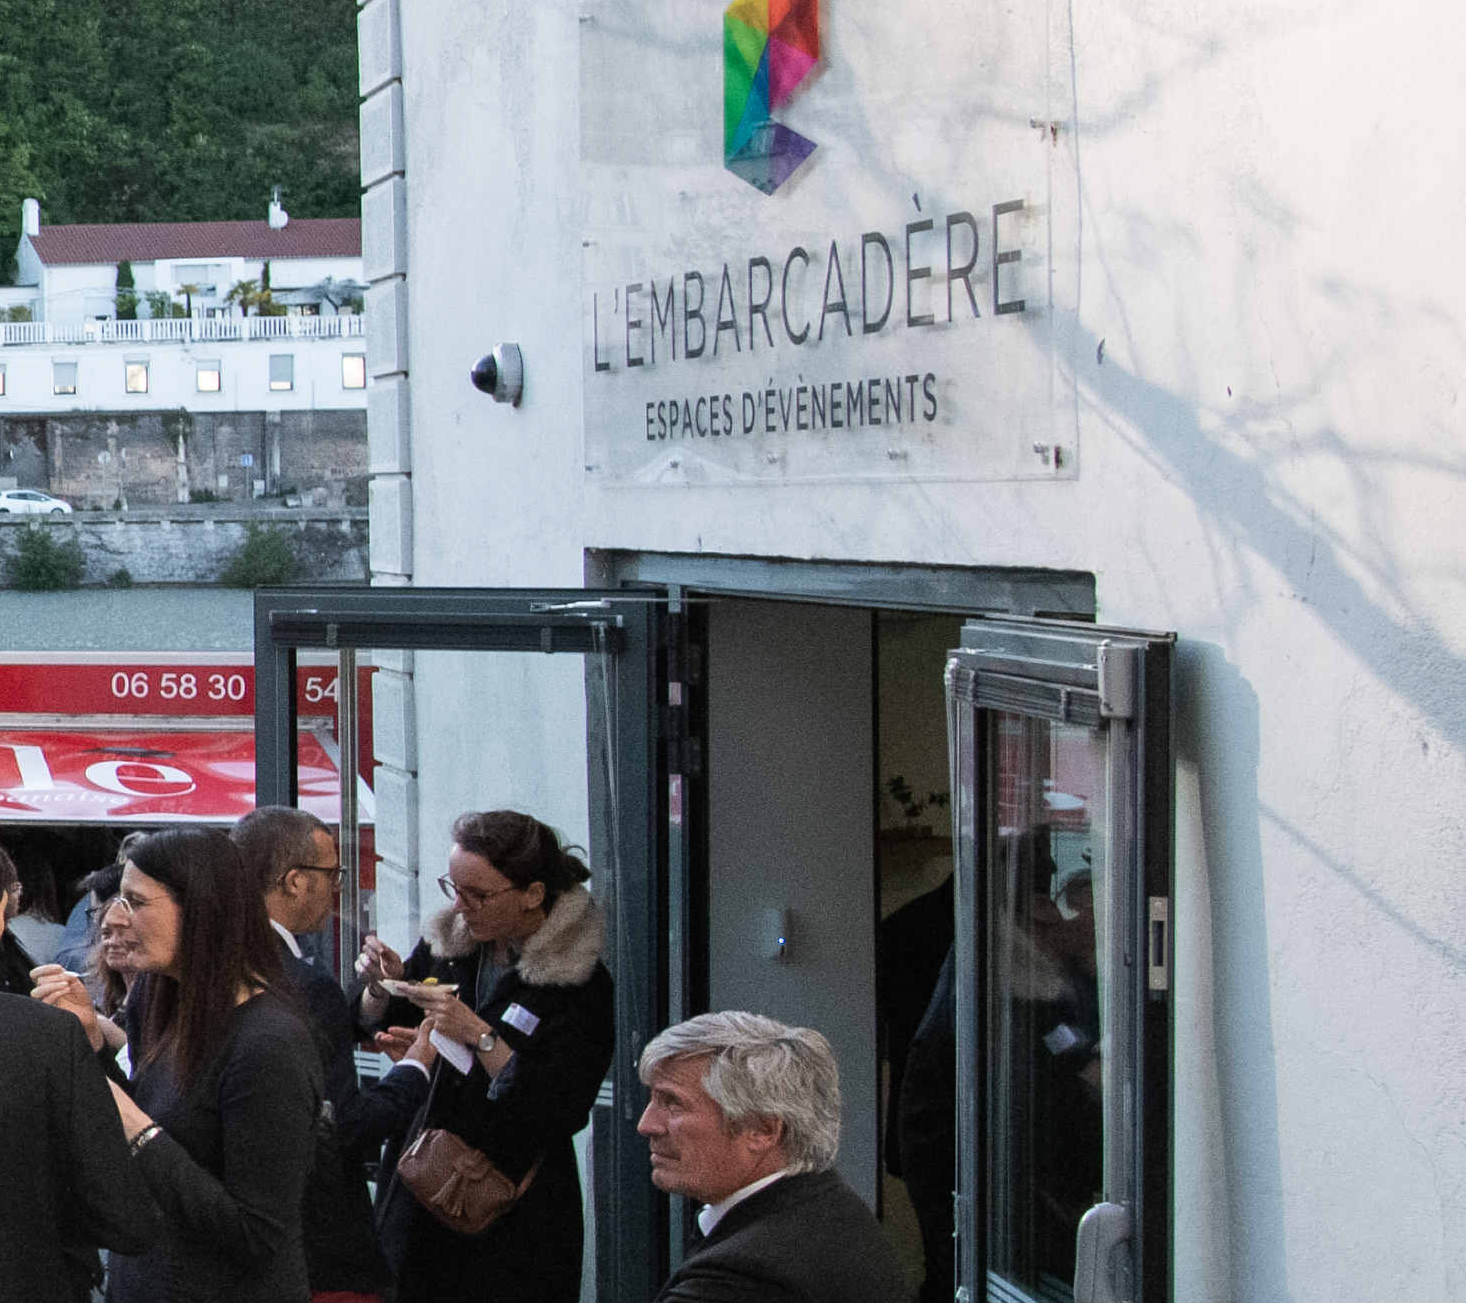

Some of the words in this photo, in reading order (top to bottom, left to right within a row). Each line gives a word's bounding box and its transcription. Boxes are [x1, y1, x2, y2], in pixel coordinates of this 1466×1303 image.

[593, 193, 1026, 372] L'EMBARCADÈRE
[645, 394, 734, 441] ESPACES
[111, 672, 149, 698] 06
[159, 673, 198, 699] 58
[207, 674, 245, 700] 30
[305, 677, 340, 703] 54
